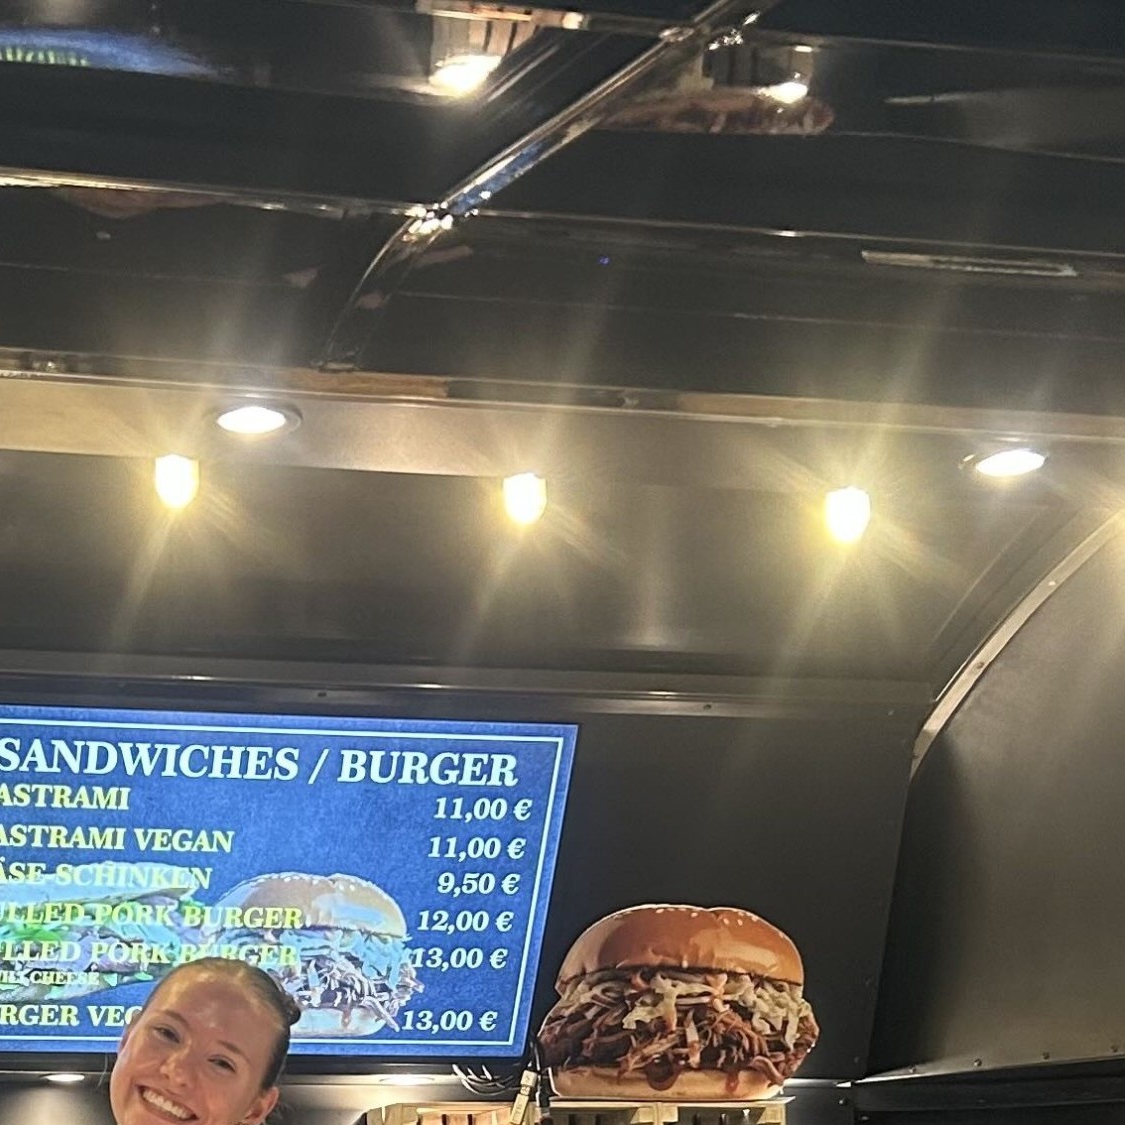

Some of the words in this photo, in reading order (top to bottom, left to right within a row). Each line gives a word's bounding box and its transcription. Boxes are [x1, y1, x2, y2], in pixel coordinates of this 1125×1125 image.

[308, 748, 330, 785] /
[337, 749, 518, 787] BURGER
[433, 797, 508, 823] 11,00
[513, 799, 533, 821] €
[133, 828, 235, 853] VEGAN
[427, 836, 501, 862] 11,00
[507, 837, 527, 860] €
[437, 872, 496, 898] 9,50
[501, 873, 521, 895] €
[89, 903, 174, 926] PORK
[183, 905, 304, 929] BURGER
[417, 910, 490, 935] 12,00
[495, 911, 515, 932] €
[90, 941, 171, 964] PORK
[412, 947, 484, 972] 13,00
[489, 948, 509, 969] €
[401, 1010, 474, 1034] 13,00
[478, 1011, 499, 1032] €
